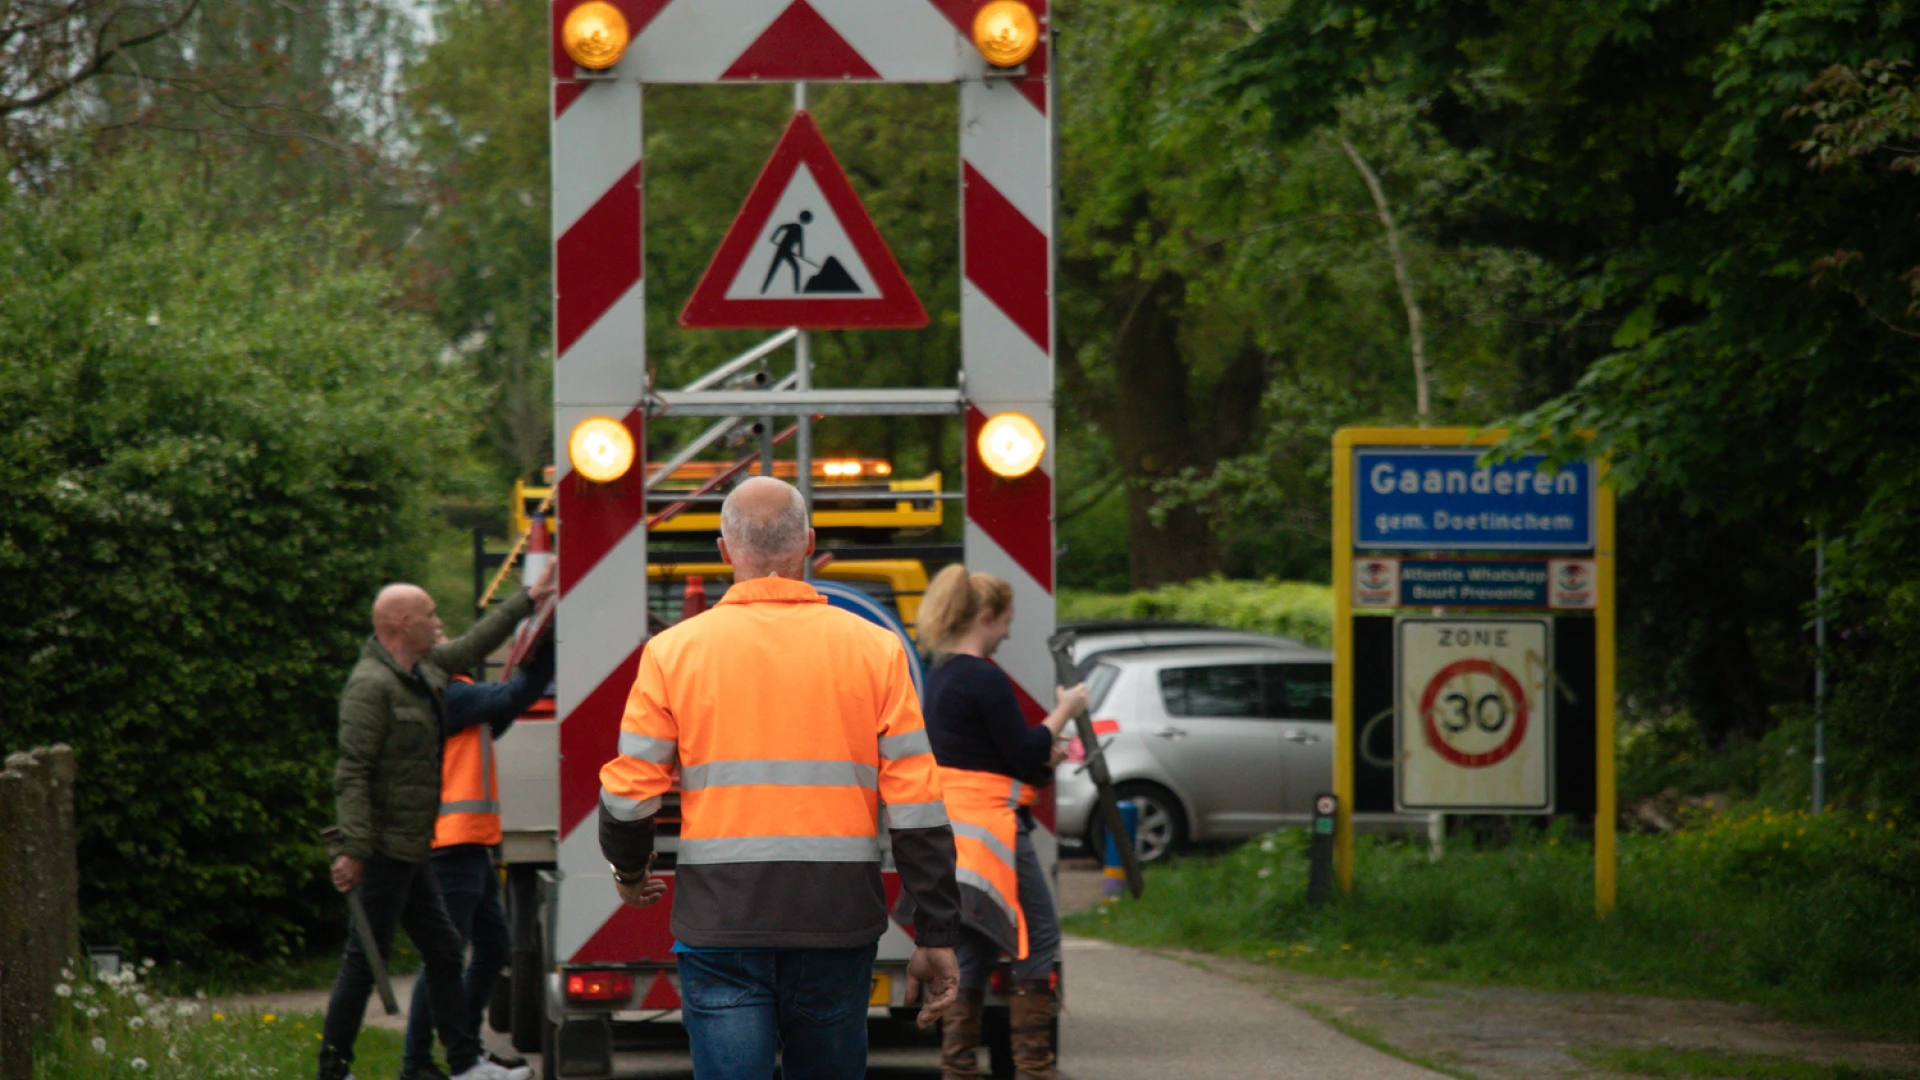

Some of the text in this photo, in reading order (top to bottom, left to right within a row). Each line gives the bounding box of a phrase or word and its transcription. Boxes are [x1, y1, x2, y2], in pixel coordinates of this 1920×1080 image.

[1369, 462, 1578, 495] Gaanderen
[1374, 510, 1574, 533] gem. Doetinchem
[1401, 566, 1547, 585] Attentie WhatsApp
[1412, 585, 1535, 601] Buurt Preventie
[1437, 629, 1510, 648] ZONE
[1443, 693, 1507, 734] 30
